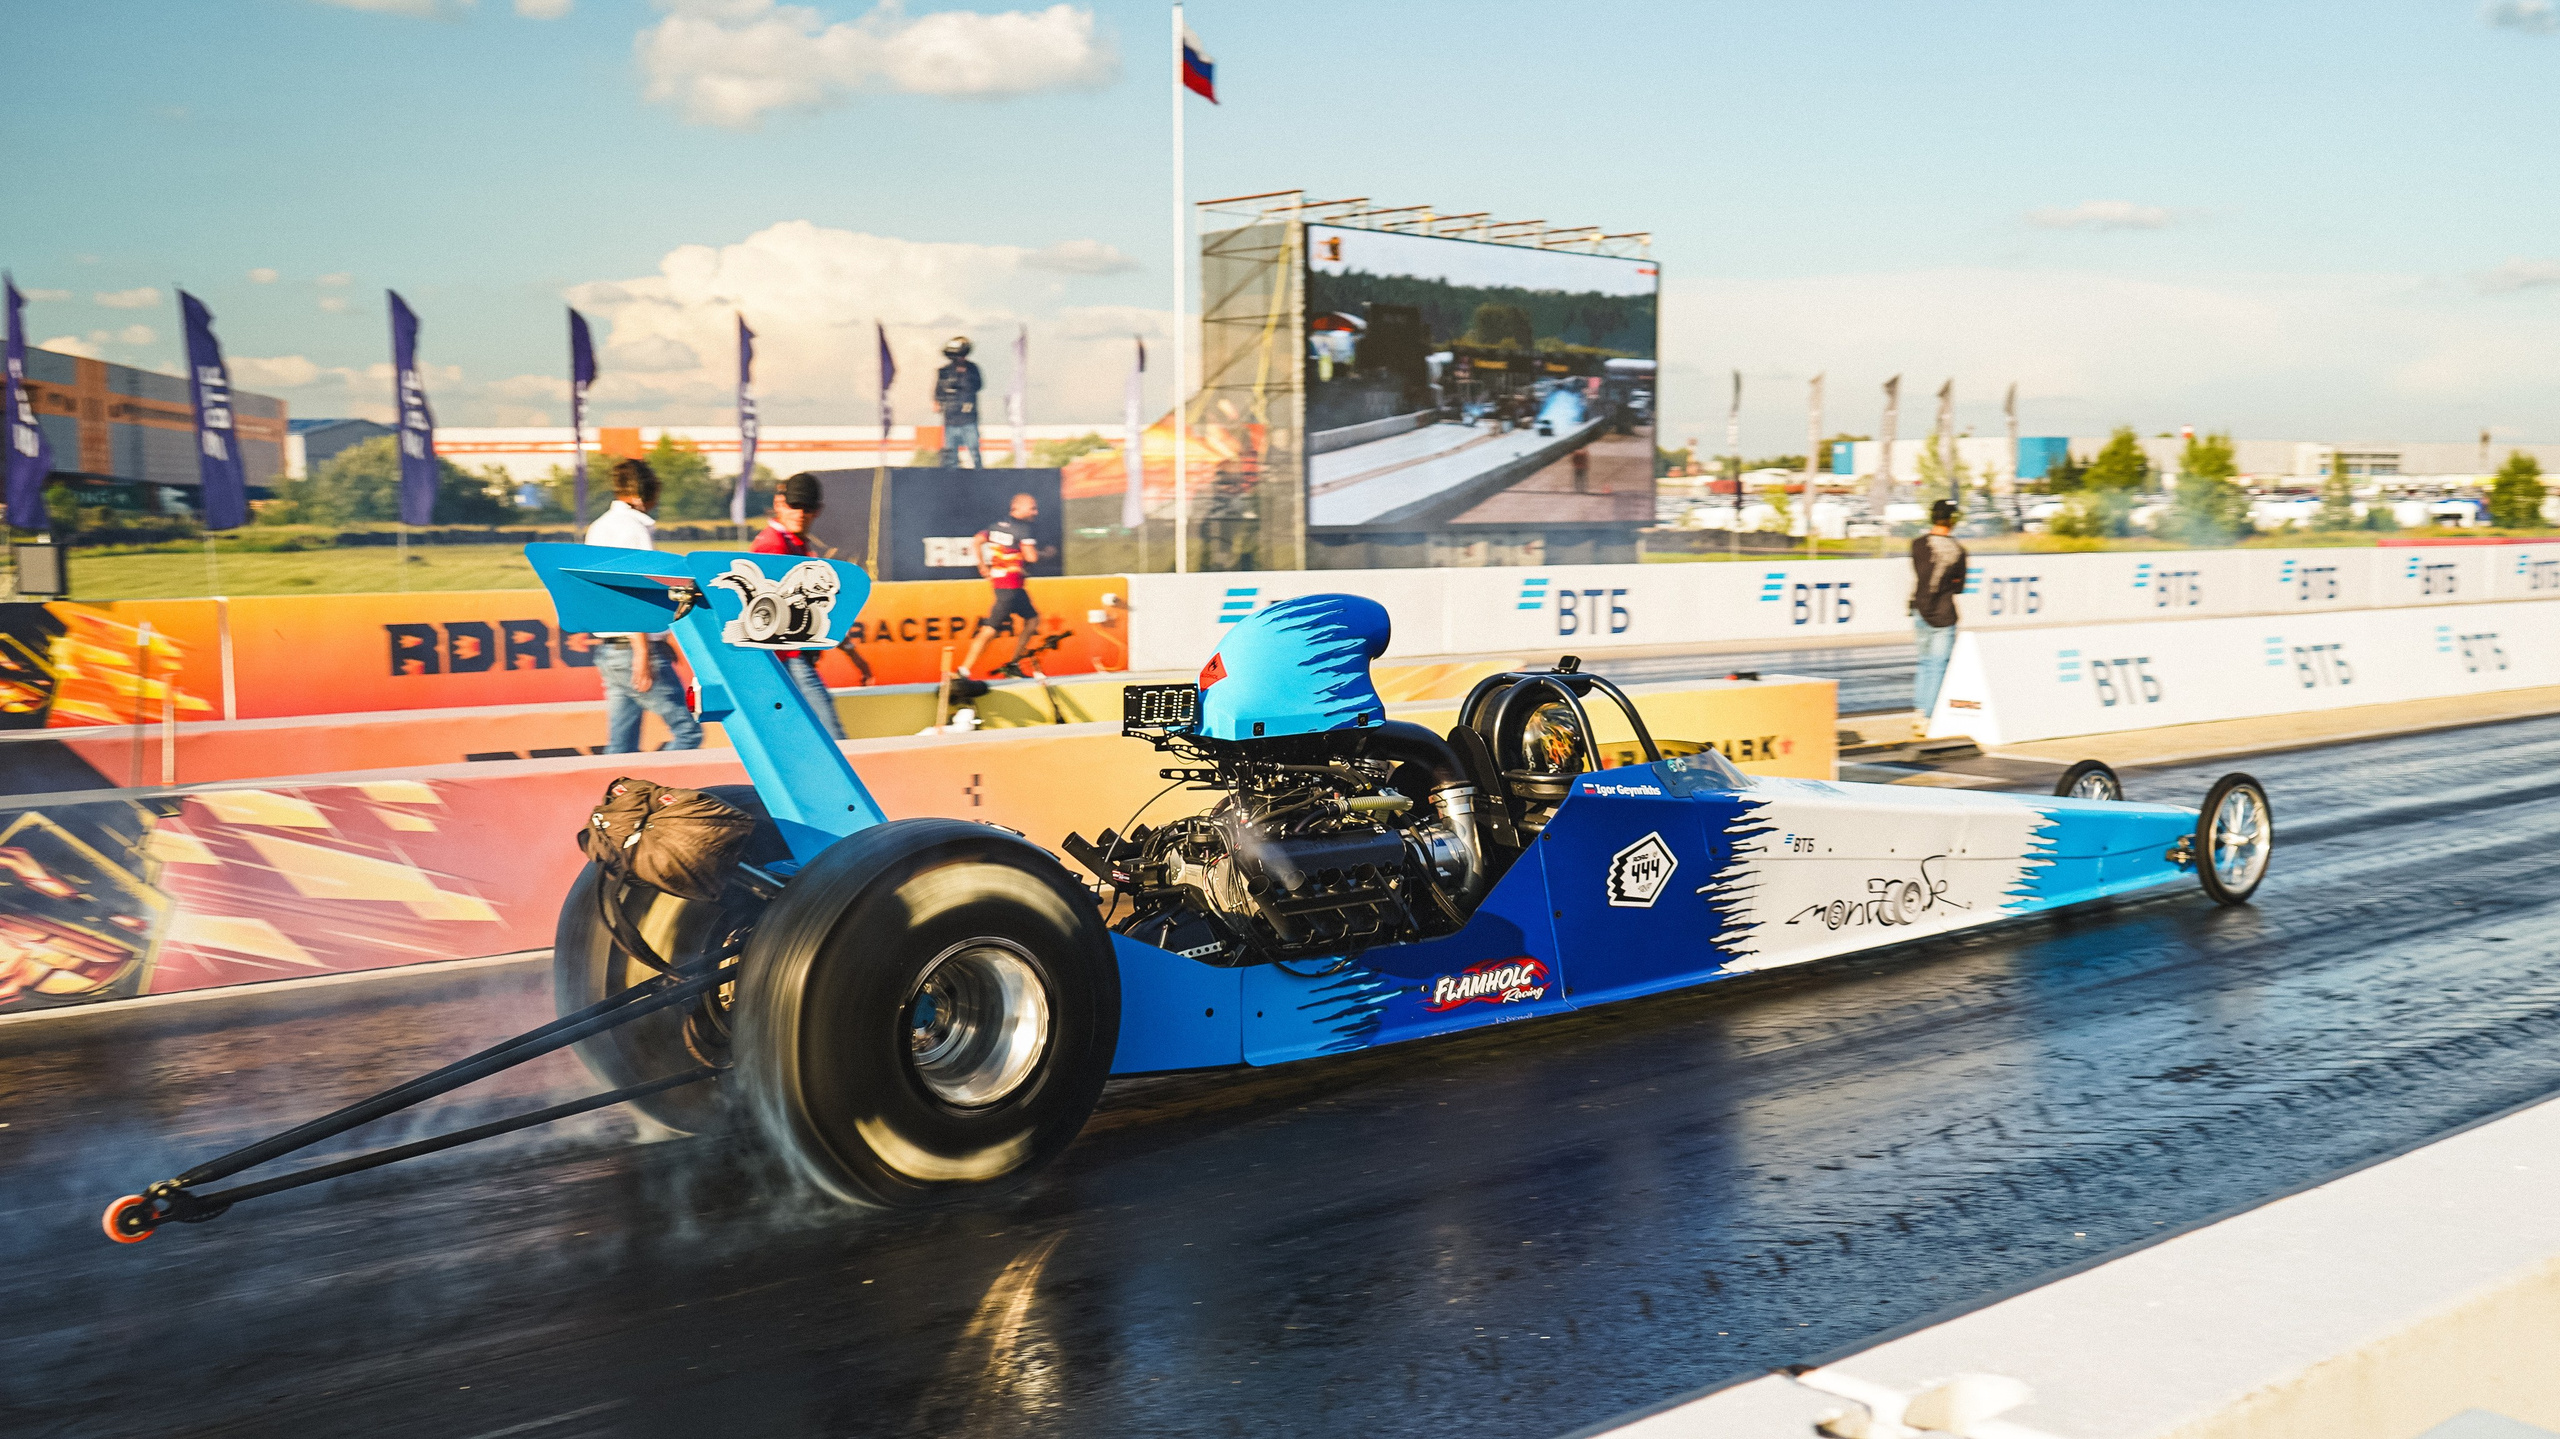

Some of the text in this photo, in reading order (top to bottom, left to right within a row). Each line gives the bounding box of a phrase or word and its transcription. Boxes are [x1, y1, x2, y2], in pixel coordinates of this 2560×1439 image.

[1989, 576, 2043, 615] ВТБ
[2156, 571, 2202, 607] ВТБ
[2299, 567, 2337, 600] ВТБ
[2423, 564, 2456, 595] ВТБ
[1559, 589, 1630, 636] ВТБ
[1794, 582, 1852, 625] ВТБ
[2292, 644, 2353, 688] ВТБ
[2460, 633, 2510, 673] ВТБ
[2091, 656, 2163, 707] ВТБ
[1595, 783, 1615, 797] Igor
[1793, 837, 1815, 853] ВТБ
[1631, 858, 1660, 884] 444
[1434, 962, 1536, 1004] FLAMHOLC
[1502, 986, 1544, 1004] Racing
